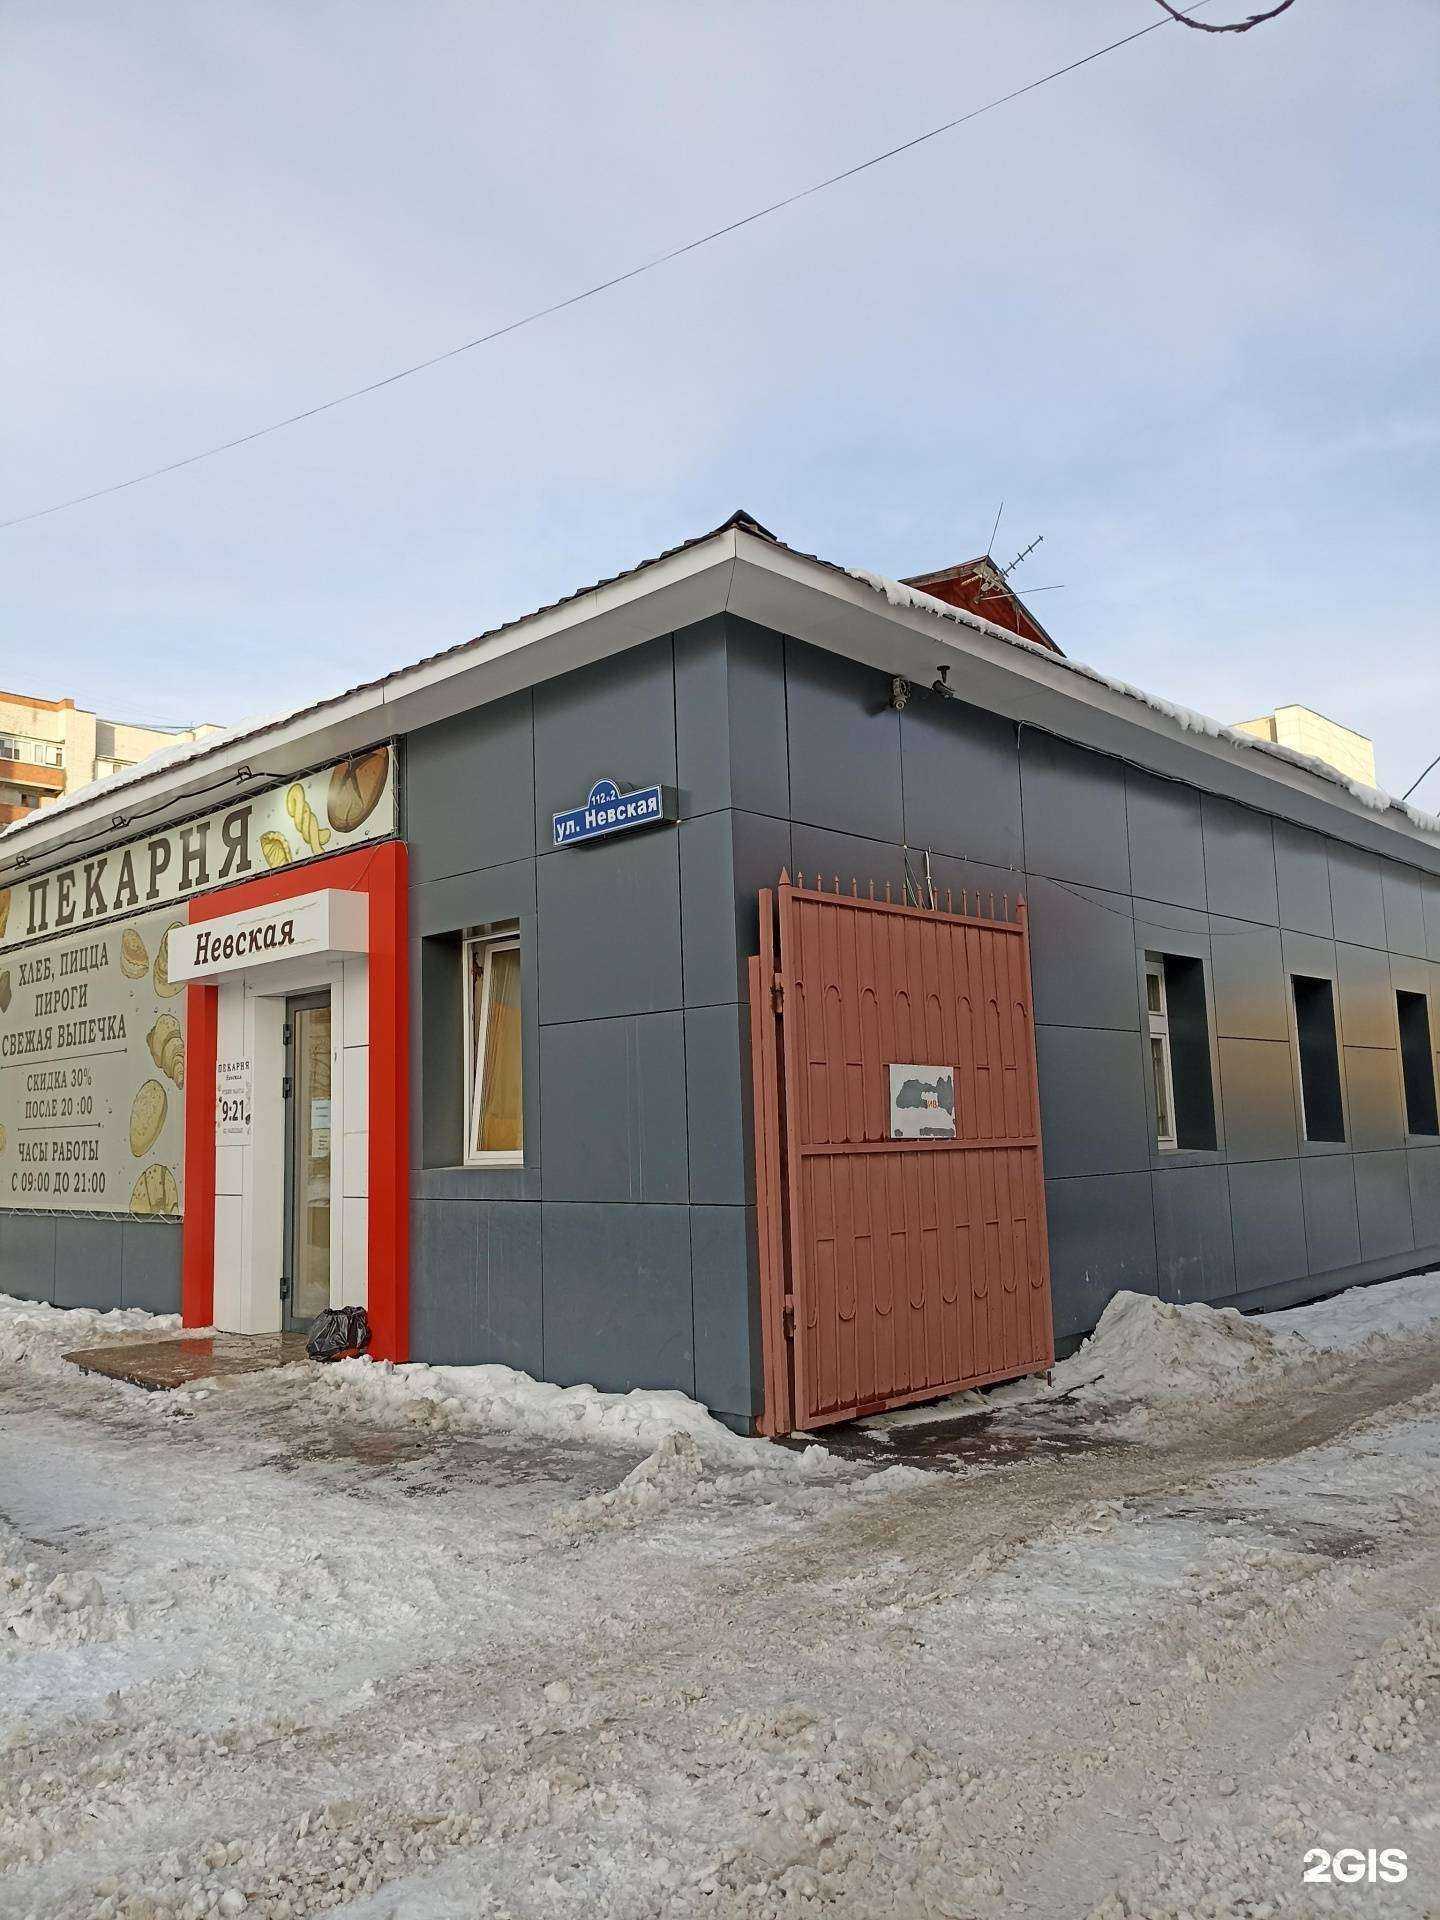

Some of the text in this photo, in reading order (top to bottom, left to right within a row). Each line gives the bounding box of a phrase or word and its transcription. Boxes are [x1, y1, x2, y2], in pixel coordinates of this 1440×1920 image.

[556, 797, 657, 842] ул. Невская
[26, 805, 253, 935] ПЕКАРНЯ
[193, 919, 295, 966] Невская
[19, 942, 109, 987] ХЛЕБ, ПИЦЦА
[34, 983, 88, 1017] ПИРОГИ
[2, 1014, 127, 1057] СВЕЖАЯ ВЫПЕЧКА
[26, 1066, 93, 1093] СКИДКА 30%
[25, 1097, 59, 1120] ПОСЛЕ
[222, 1099, 244, 1122] 9:21
[18, 1139, 99, 1164] ЧАСЫ РАБОТЫ
[20, 1172, 50, 1193] 09:00
[53, 1172, 70, 1195] ДО
[73, 1172, 106, 1193] 21:00
